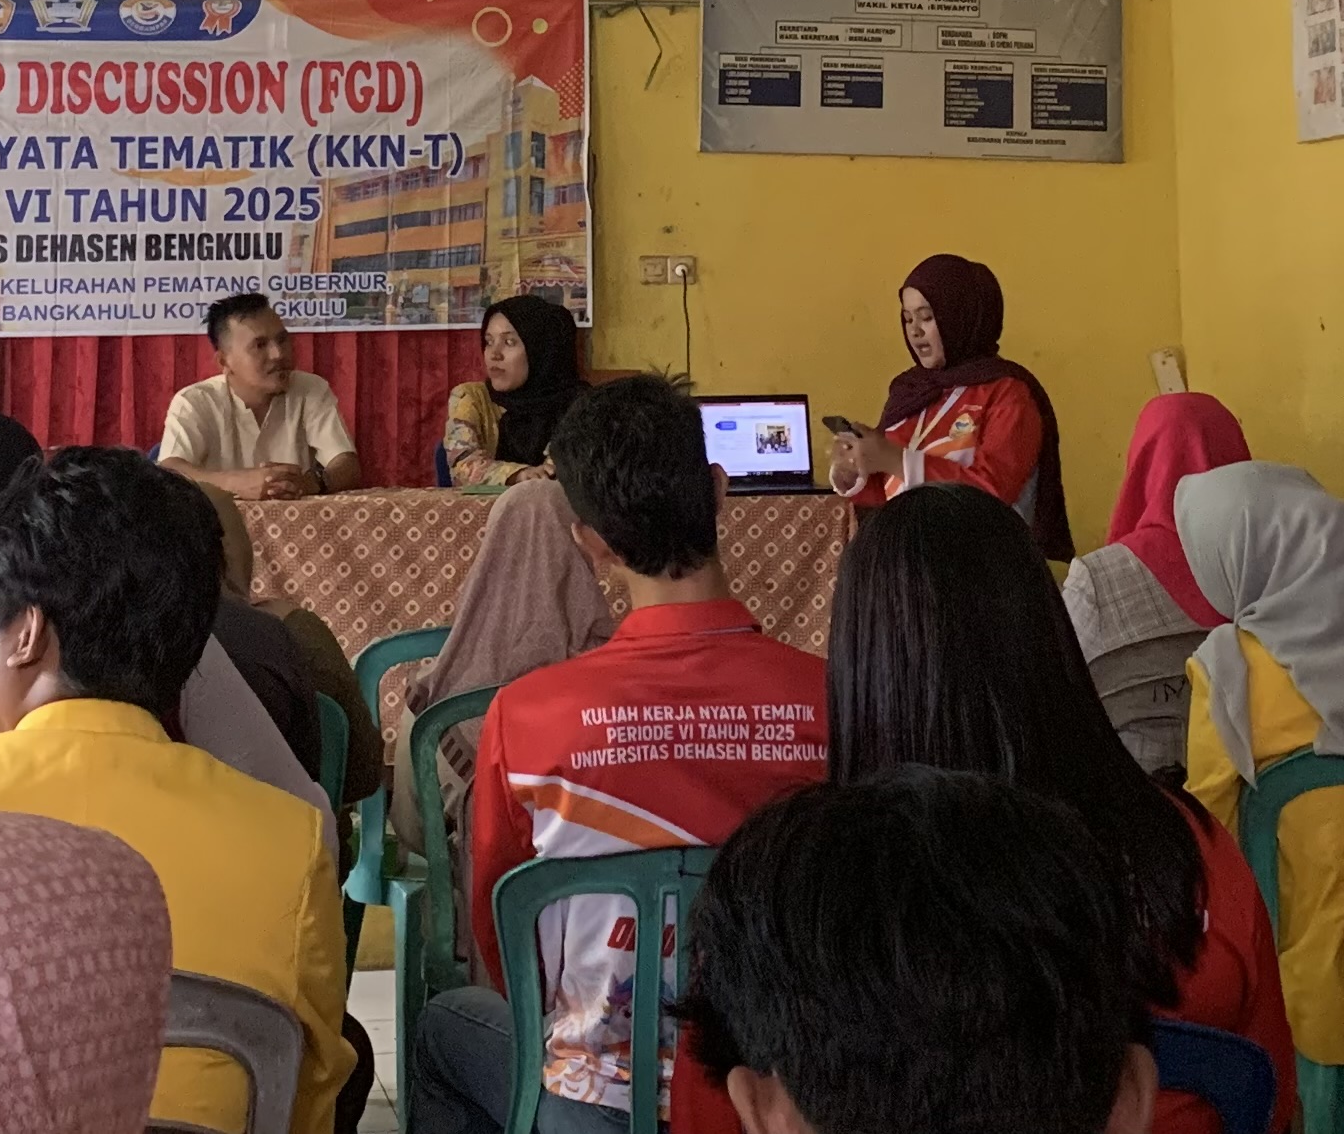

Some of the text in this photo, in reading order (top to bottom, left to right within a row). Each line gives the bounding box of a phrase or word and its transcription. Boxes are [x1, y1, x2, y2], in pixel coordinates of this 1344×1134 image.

[891, 3, 923, 11] KETUA
[16, 60, 288, 116] DISCUSSION
[299, 59, 425, 127] (FGD)
[111, 134, 294, 170] TEMATIK
[307, 132, 464, 177] (KKN-T)
[6, 187, 53, 224] VI
[66, 187, 207, 223] TAHUN
[223, 186, 322, 223] 2025
[15, 233, 137, 263] DEHASEN
[144, 232, 283, 262] BENGKULU
[0, 277, 136, 296] KELURAHAN
[144, 276, 261, 294] PEMATANG
[269, 274, 393, 294] GUBERNUR,
[2, 304, 156, 323] BANGKAHULU
[164, 303, 207, 320] KOT
[273, 298, 346, 318] GKULU
[581, 704, 815, 726] KULIAH KERJA NYATA TEMATIK
[606, 723, 795, 744] PERIODE VI TAHUN 2025
[571, 743, 828, 770] UNIVERSITAS DEHASEN BENGKULU
